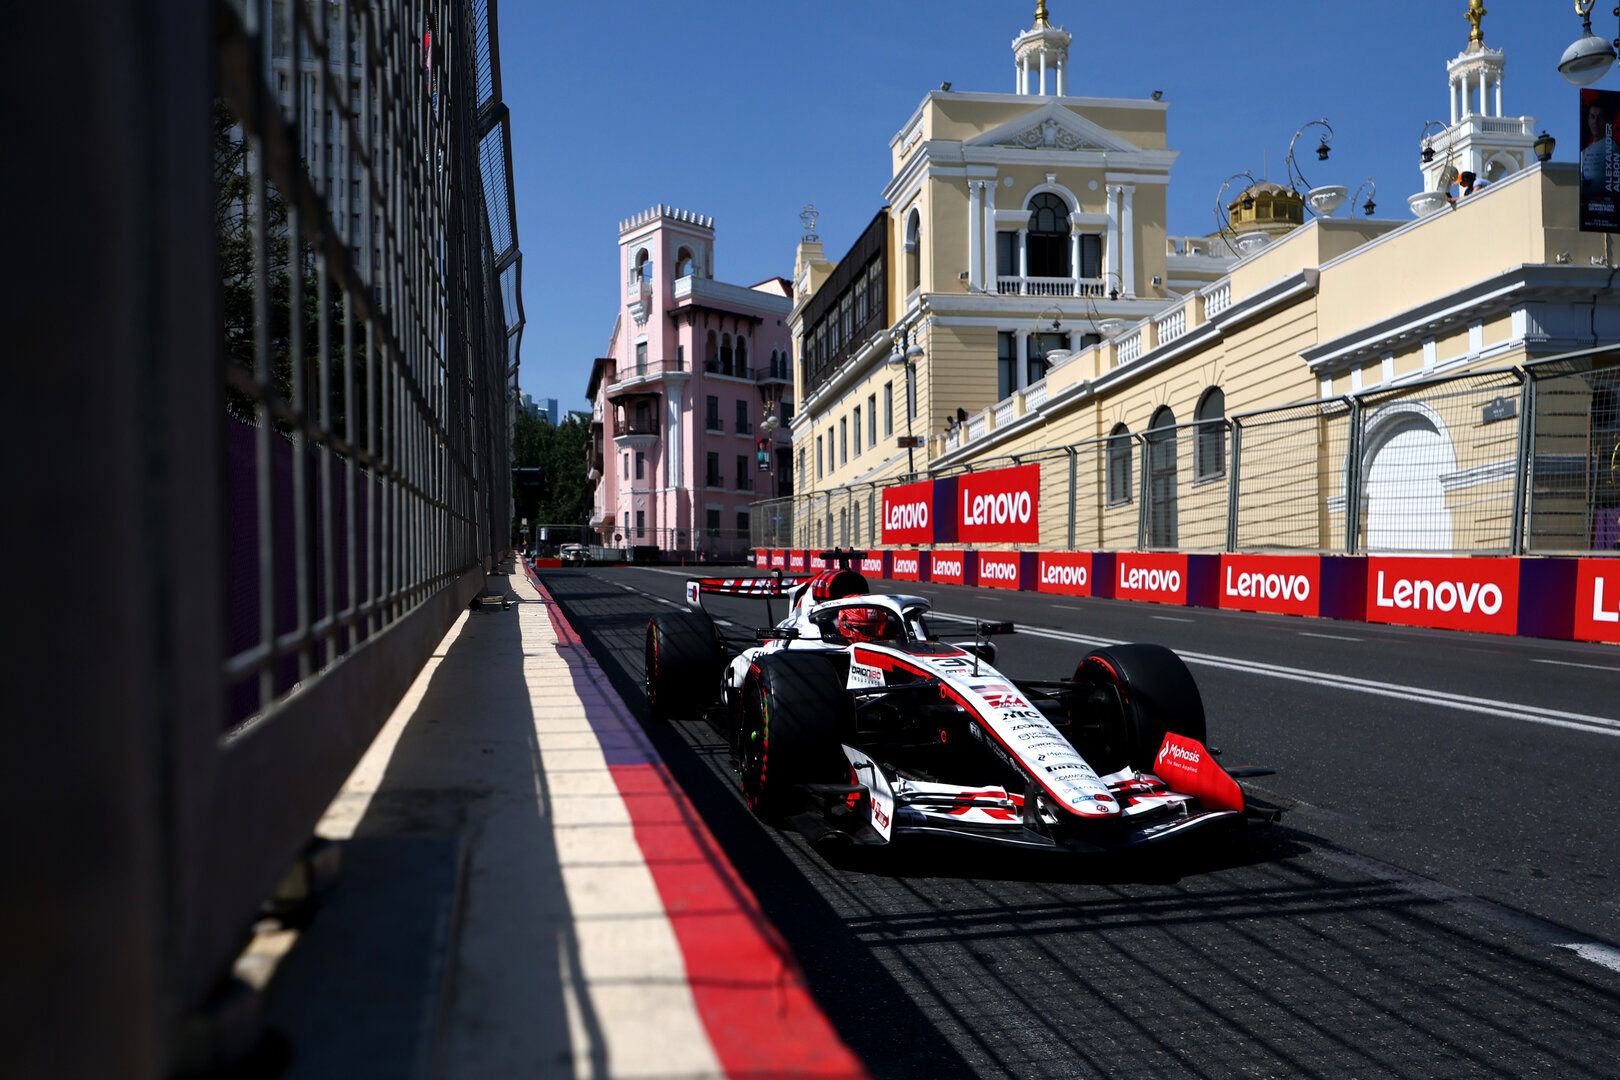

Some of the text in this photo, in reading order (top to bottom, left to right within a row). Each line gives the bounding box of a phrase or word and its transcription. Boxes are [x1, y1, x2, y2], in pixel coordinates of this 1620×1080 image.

[1605, 123, 1613, 192] ALEXANDER
[885, 499, 929, 531] Lenovo
[963, 488, 1032, 526] Lenovo
[861, 557, 882, 572] Lenovo
[893, 556, 918, 574] Lenovo
[932, 556, 962, 577] Lenovo
[980, 557, 1017, 581] Lenovo
[1041, 560, 1088, 586] Lenovo
[1120, 562, 1181, 593] Lenovo
[1226, 565, 1311, 602] Lenovo
[1376, 570, 1503, 615] Lenovo
[1592, 576, 1620, 623] L
[851, 665, 881, 680] ORION180
[1168, 743, 1201, 763] Mphasis
[1173, 761, 1182, 769] Next
[1182, 763, 1198, 774] Applied
